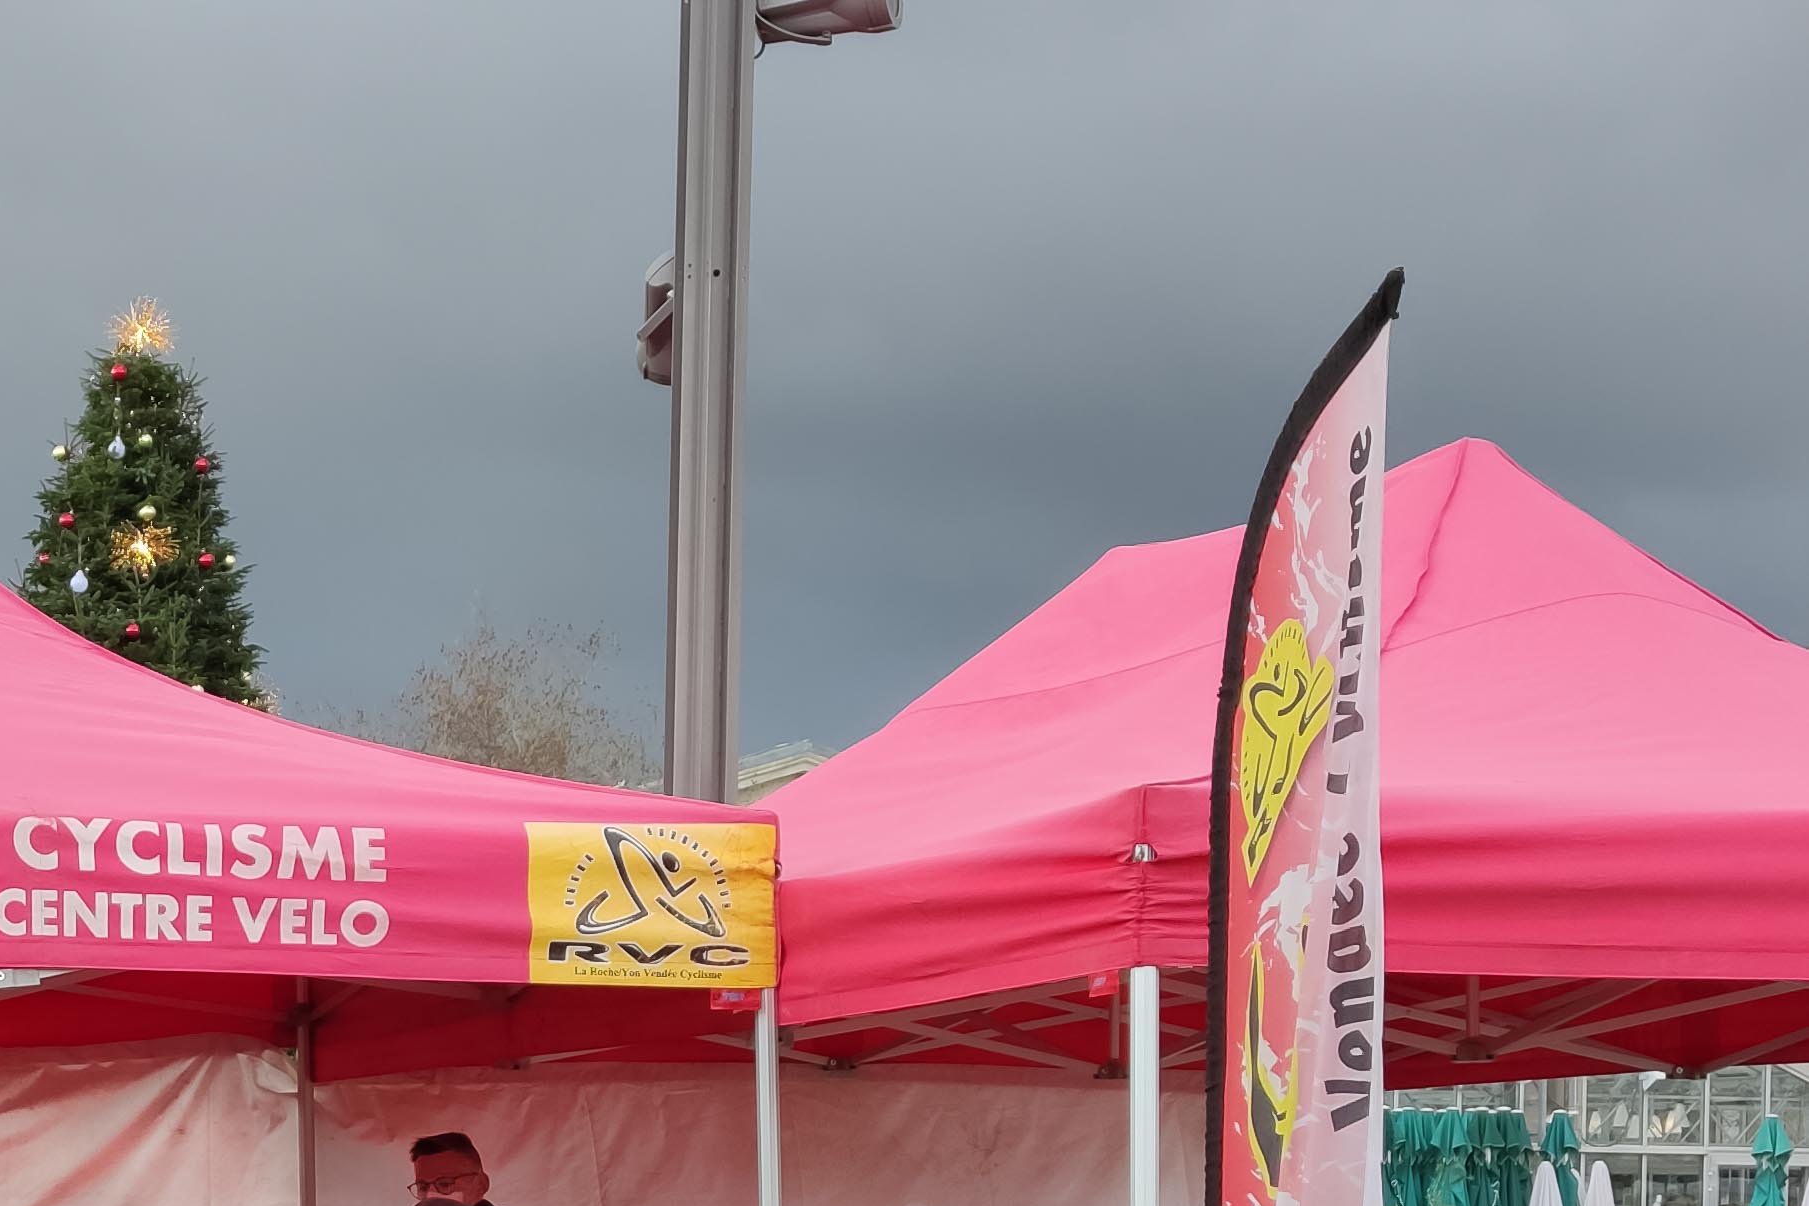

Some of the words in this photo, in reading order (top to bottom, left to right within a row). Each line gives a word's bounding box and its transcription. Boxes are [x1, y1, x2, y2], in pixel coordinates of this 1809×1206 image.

[13, 815, 389, 883] CYCLISME
[231, 896, 390, 948] VELO
[547, 940, 752, 967] RVC
[574, 966, 587, 977] La
[643, 967, 678, 979] Vendée
[679, 968, 723, 981] Cyclisme
